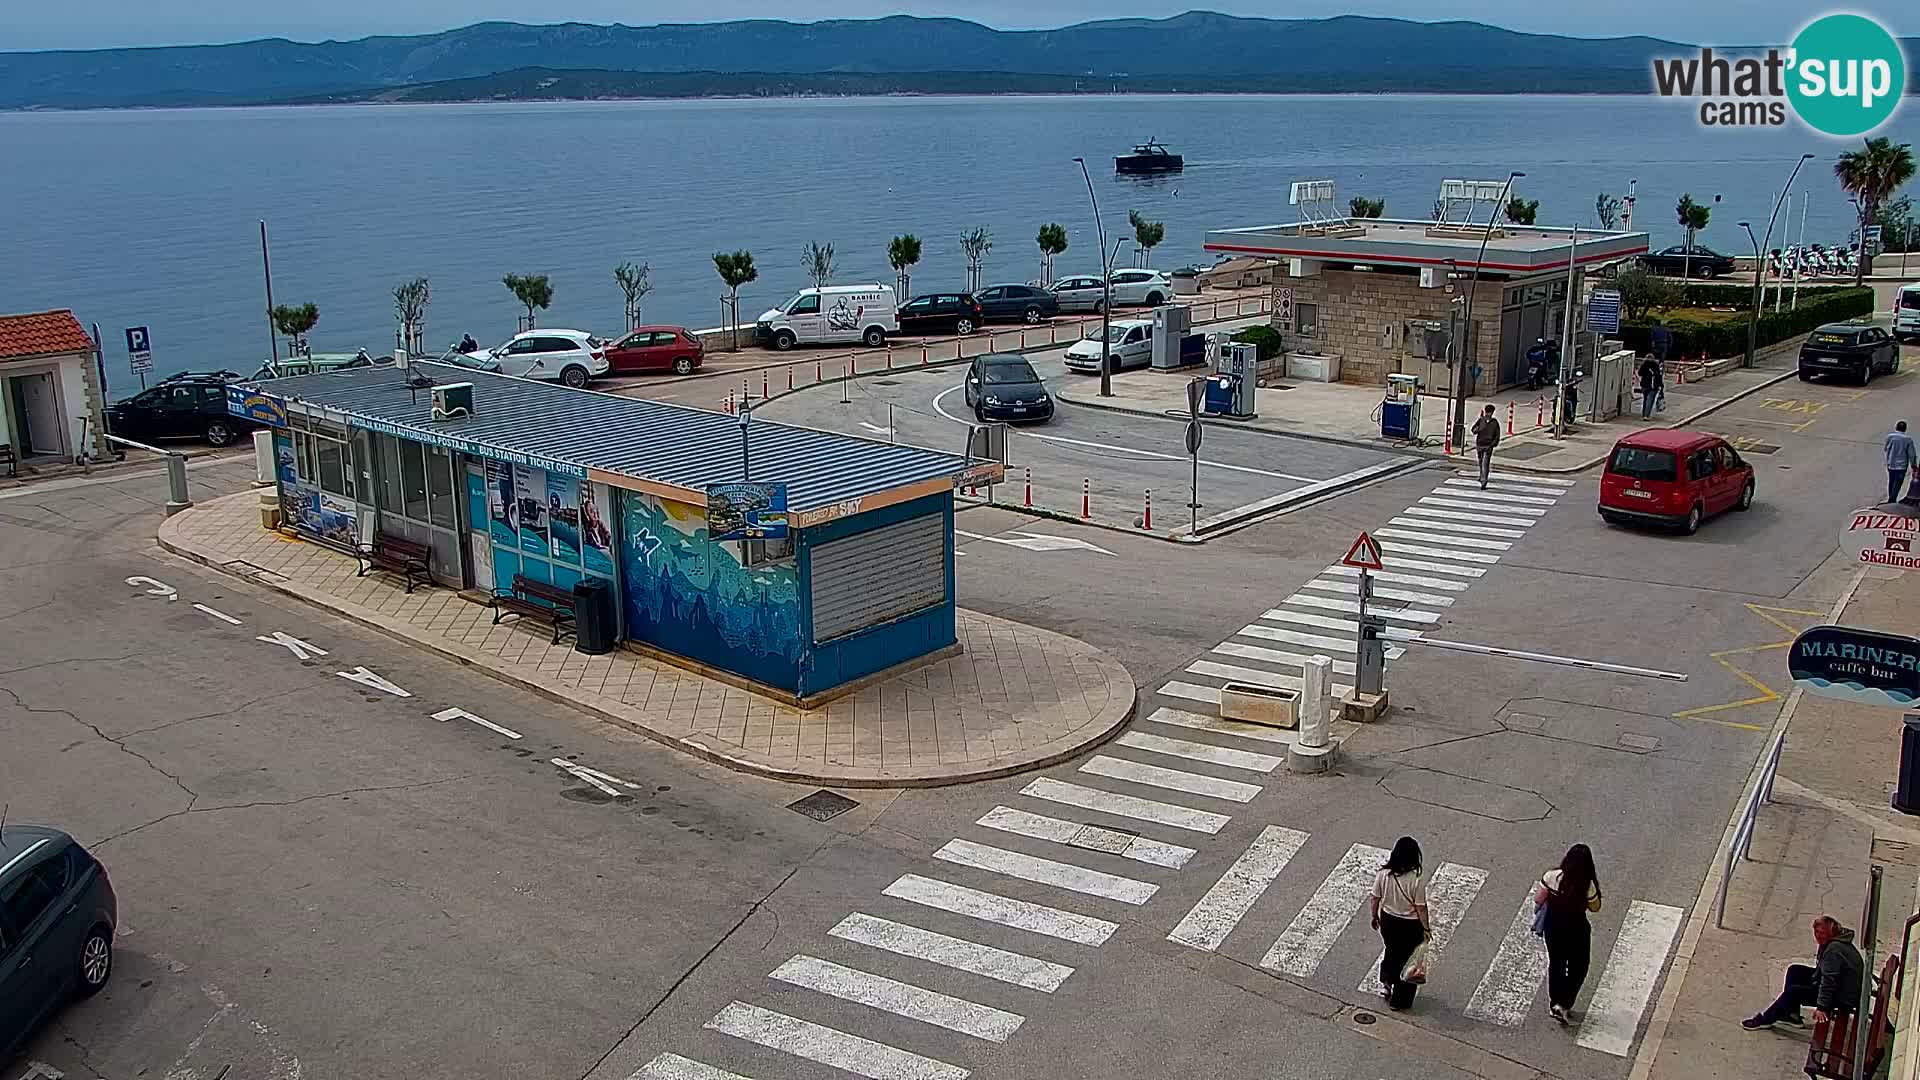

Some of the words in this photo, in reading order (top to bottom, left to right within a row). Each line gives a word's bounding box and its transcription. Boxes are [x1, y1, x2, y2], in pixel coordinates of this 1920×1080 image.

[131, 331, 143, 348] P
[1760, 398, 1830, 414] TAXI
[397, 426, 437, 444] AUTOBUSNA
[437, 435, 469, 451] POSTAJA
[479, 445, 494, 457] BUS
[495, 451, 527, 465] STATION
[529, 456, 555, 471] TICKET
[556, 462, 583, 477] OFFICE
[1847, 515, 1920, 532] PIZZE
[1882, 529, 1917, 540] GRILL
[1871, 665, 1897, 680] bar
